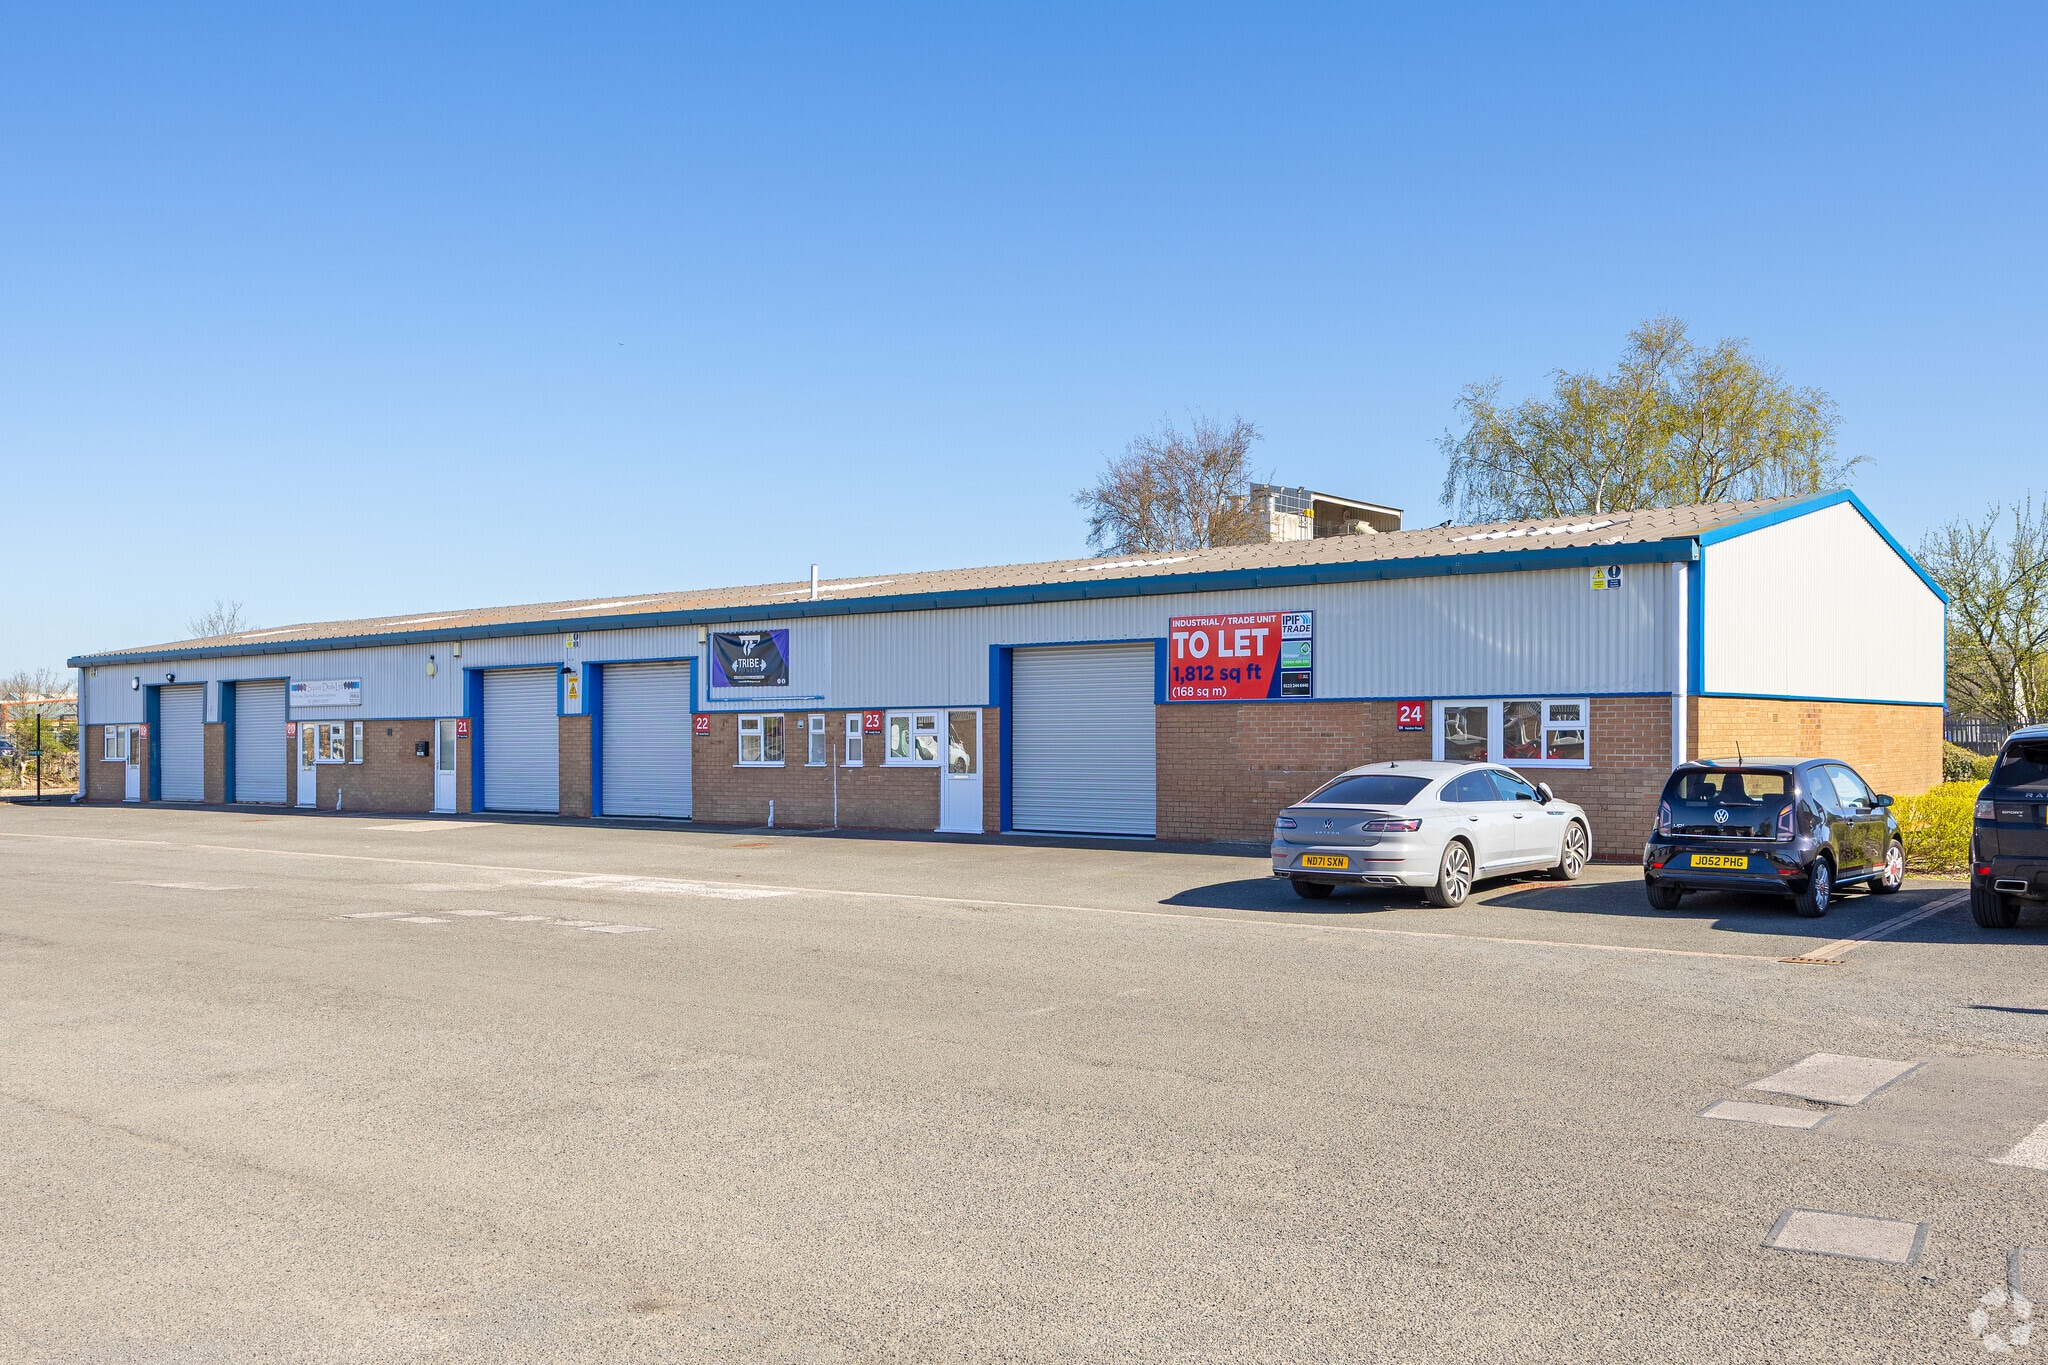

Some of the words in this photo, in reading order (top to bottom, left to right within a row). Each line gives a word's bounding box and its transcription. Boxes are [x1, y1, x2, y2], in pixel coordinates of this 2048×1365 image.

[1172, 617, 1219, 628] INDUSTRIAL
[1227, 616, 1254, 625] TRADE
[1256, 615, 1277, 624] UNIT
[1282, 615, 1300, 625] IPIF
[1282, 624, 1311, 633] TRADE
[1172, 630, 1210, 659] TO
[1218, 628, 1269, 658] LET
[738, 658, 759, 668] TRIBE
[1173, 665, 1214, 685] 1,812
[1219, 667, 1241, 683] sq
[1246, 663, 1262, 680] ft
[1172, 686, 1194, 698] (168
[1196, 688, 1209, 698] sq
[1212, 685, 1227, 697] m)
[1400, 705, 1422, 722] 24
[458, 721, 467, 732] 21
[696, 717, 708, 730] 22
[866, 714, 879, 728] 23
[287, 724, 296, 734] 20
[1306, 856, 1325, 867] ND71
[1326, 857, 1344, 867] SXN
[1723, 857, 1744, 867] PHG
